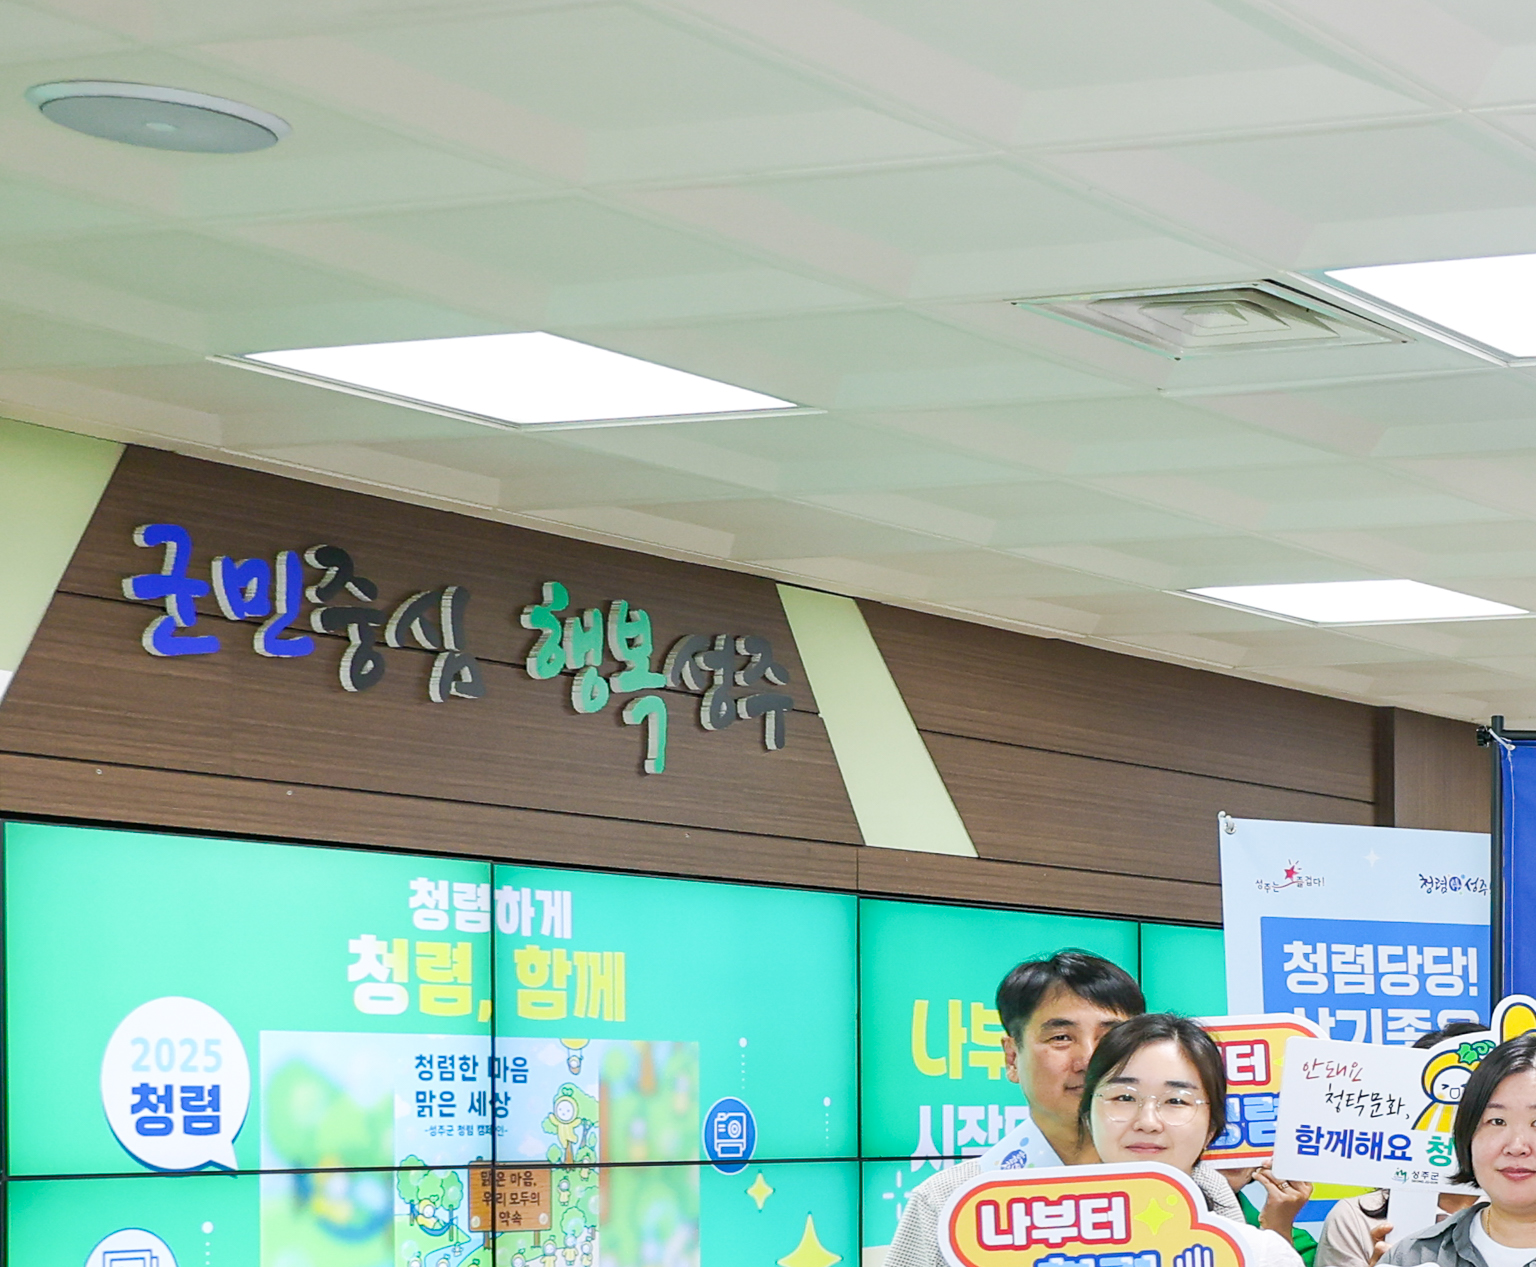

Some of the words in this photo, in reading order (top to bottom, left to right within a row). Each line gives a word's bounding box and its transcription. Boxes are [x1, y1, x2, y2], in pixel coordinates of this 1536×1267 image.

[1254, 878, 1280, 894] 성주는
[408, 876, 574, 940] 청렴하게
[346, 932, 493, 1024] 청렴,
[513, 944, 627, 1023] 함께
[1282, 940, 1480, 998] 청렴당당!
[130, 1036, 224, 1074] 2025
[414, 1053, 479, 1083] 청렴한
[488, 1055, 530, 1085] 마음
[130, 1082, 223, 1138] 청렴
[414, 1089, 457, 1119] 맑은
[468, 1090, 512, 1120] 세상
[1323, 1083, 1411, 1121] 청탁문화,
[1294, 1124, 1413, 1162] 함께해요
[1411, 1170, 1440, 1181] 성주군
[509, 1191, 541, 1207] 모두의
[499, 1211, 523, 1227] 약속
[977, 1194, 1130, 1250] 나부터
